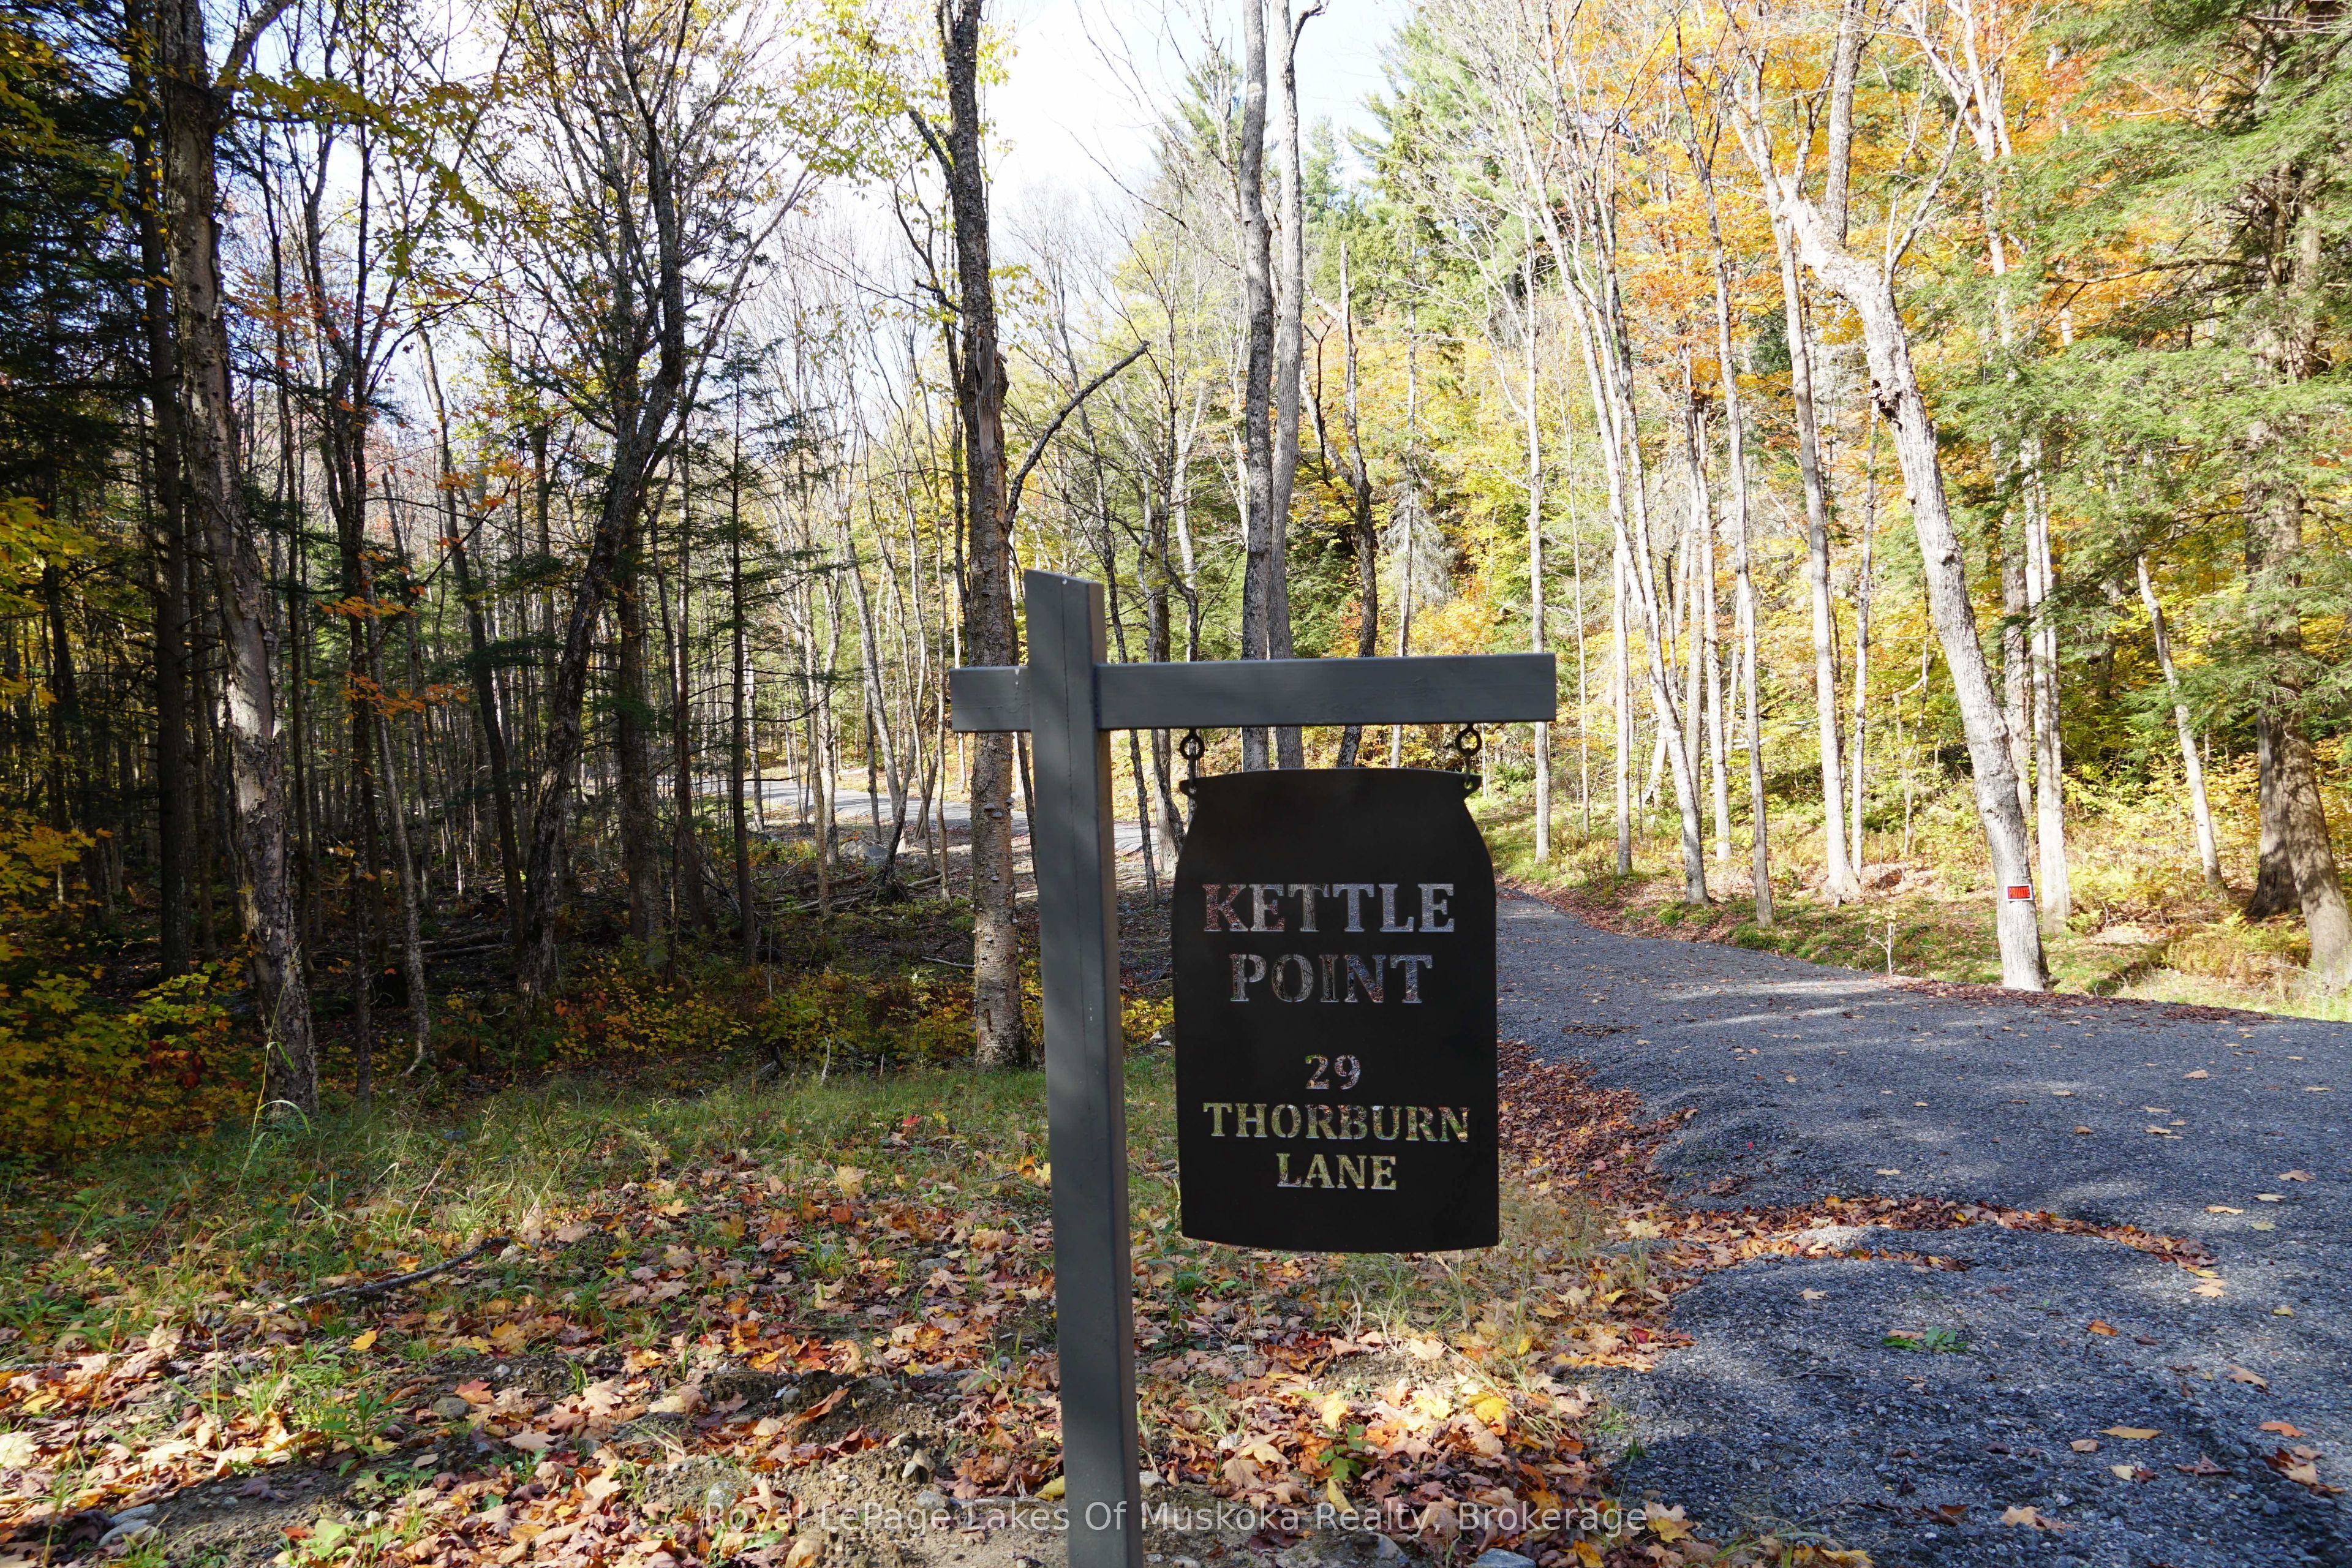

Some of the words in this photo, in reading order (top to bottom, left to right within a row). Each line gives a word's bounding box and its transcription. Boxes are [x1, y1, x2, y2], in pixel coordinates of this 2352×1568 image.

[1202, 883, 1455, 932] KETTLE
[2008, 887, 2029, 898] PRIVATE
[1229, 954, 1433, 1003] POINT
[1305, 1054, 1362, 1090] 29
[1203, 1102, 1470, 1142] THORBURN
[1276, 1153, 1396, 1190] LANE
